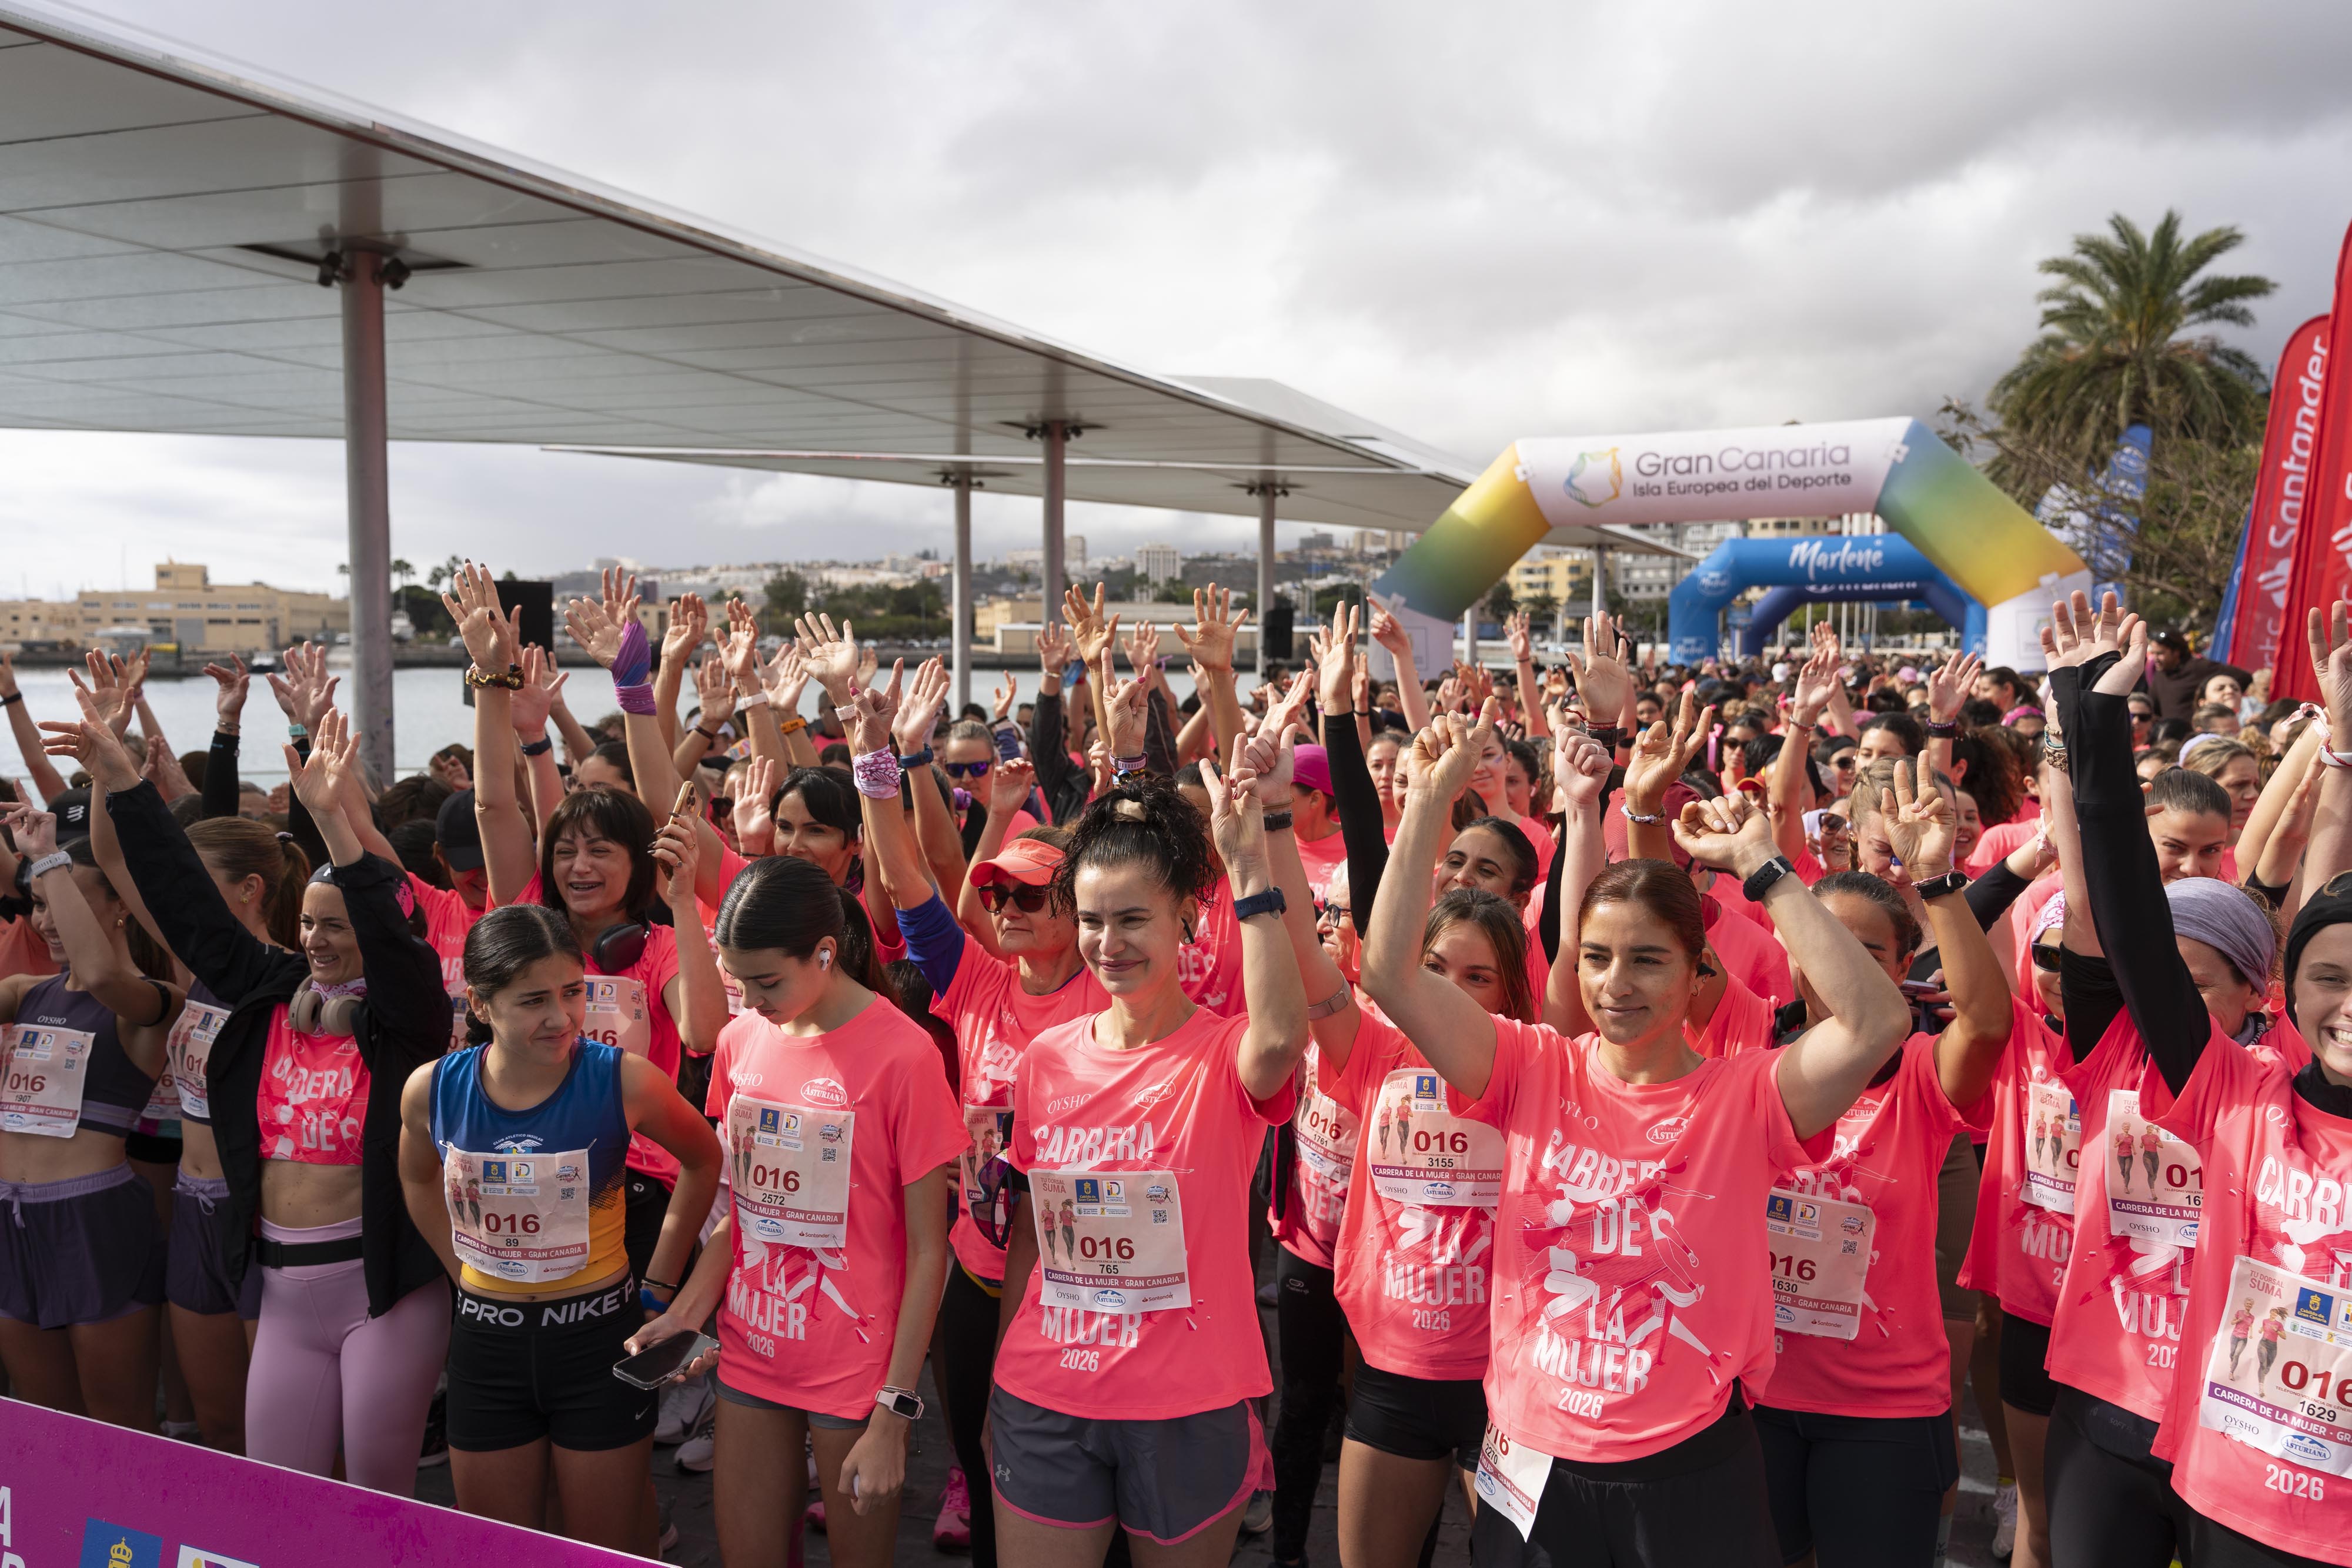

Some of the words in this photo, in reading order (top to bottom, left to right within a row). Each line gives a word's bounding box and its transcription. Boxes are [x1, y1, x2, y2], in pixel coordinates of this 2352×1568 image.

[1633, 483, 1661, 497] Isla
[1667, 479, 1739, 496] Europea
[1745, 476, 1772, 490] del
[1778, 472, 1851, 491] Deporte
[1790, 541, 1883, 580] Marlene
[37, 1015, 66, 1025] OYSHO
[10, 1073, 46, 1092] 016
[1389, 1081, 1407, 1089] SUMA
[15, 1094, 31, 1103] 1907
[803, 1088, 844, 1103] ASTURIANA
[1048, 1094, 1091, 1114] OYSHO
[2040, 1098, 2060, 1109] SUMA
[15, 1105, 27, 1113] MUJER
[45, 1108, 74, 1118] CANARIA
[735, 1109, 752, 1120] SUMA
[302, 1109, 336, 1151] DE
[1309, 1111, 1341, 1139] 016
[527, 1134, 543, 1142] INSULAR
[1034, 1121, 1154, 1163] CARRERA
[1314, 1134, 1328, 1146] 1761
[1414, 1131, 1468, 1154] 016
[1310, 1141, 1324, 1154] MUJER
[1327, 1152, 1341, 1162] GRAN
[1375, 1167, 1403, 1176] CARRERA
[1428, 1158, 1454, 1168] 3155
[753, 1165, 800, 1192] 016
[2030, 1174, 2054, 1187] CARRERA
[2166, 1164, 2203, 1189] 01
[1043, 1183, 1066, 1193] SUMA
[1385, 1186, 1407, 1194] OYSHO
[2036, 1192, 2056, 1203] OYSHO
[761, 1193, 784, 1205] 2572
[2116, 1202, 2153, 1214] CARRERA
[2156, 1207, 2166, 1215] DE
[2169, 1208, 2180, 1216] LA
[485, 1213, 540, 1233] 016
[759, 1206, 780, 1216] MUJER
[787, 1211, 804, 1219] GRAN
[807, 1213, 838, 1222] CANARIA
[757, 1224, 781, 1233] ASTURIANA
[1590, 1195, 1643, 1256] DE
[2129, 1222, 2160, 1233] OYSHO
[457, 1235, 479, 1248] CARRERA
[550, 1246, 582, 1257] CANARIA
[506, 1238, 519, 1246] 89
[1080, 1236, 1134, 1260] 016
[1431, 1216, 1463, 1264] LA
[466, 1253, 485, 1265] OYSHO
[763, 1246, 786, 1297] LA
[1048, 1272, 1074, 1282] CARRERA
[1075, 1276, 1083, 1284] DE
[1147, 1276, 1180, 1286] CANARIA
[1099, 1265, 1118, 1274] 765
[1384, 1258, 1485, 1305] MUJER
[1772, 1279, 1798, 1293] 1630
[2249, 1278, 2282, 1299] SUMA
[2260, 1274, 2284, 1288] DORSAL
[1057, 1290, 1080, 1300] OYSHO
[1149, 1293, 1173, 1302] Santander
[1774, 1293, 1791, 1303] UJER
[1798, 1299, 1818, 1308] GRAN
[1820, 1303, 1852, 1313] CANARIA
[462, 1298, 524, 1326] PRO
[542, 1290, 620, 1326] NIKE
[729, 1276, 806, 1340] MUJER
[1587, 1282, 1626, 1344] LA
[2300, 1308, 2317, 1316] Cabildo
[1040, 1306, 1142, 1348] MUJER
[1412, 1309, 1450, 1330] 2026
[2309, 1315, 2327, 1323] Canaria
[747, 1330, 774, 1358] 2026
[1060, 1348, 1099, 1372] 2026
[1532, 1325, 1651, 1395] MUJER
[1559, 1388, 1605, 1419] 2026
[2276, 1386, 2301, 1397] TELÉFONO
[2301, 1393, 2325, 1405] VIOLENCIA
[2214, 1388, 2257, 1411] CARRERA
[2259, 1405, 2271, 1417] DE
[2275, 1410, 2288, 1423] LA
[2291, 1417, 2327, 1436] MUJER
[2300, 1400, 2336, 1422] 1629
[2225, 1415, 2259, 1435] OYSHO
[1485, 1443, 1498, 1465] 2270
[2284, 1440, 2326, 1459] ASTURIANA
[1478, 1473, 1493, 1494] ASTURIANA
[1481, 1458, 1494, 1474] MUJER
[1498, 1473, 1511, 1490] GRAN
[1511, 1485, 1531, 1509] CANARIA
[2264, 1463, 2324, 1501] 2026
